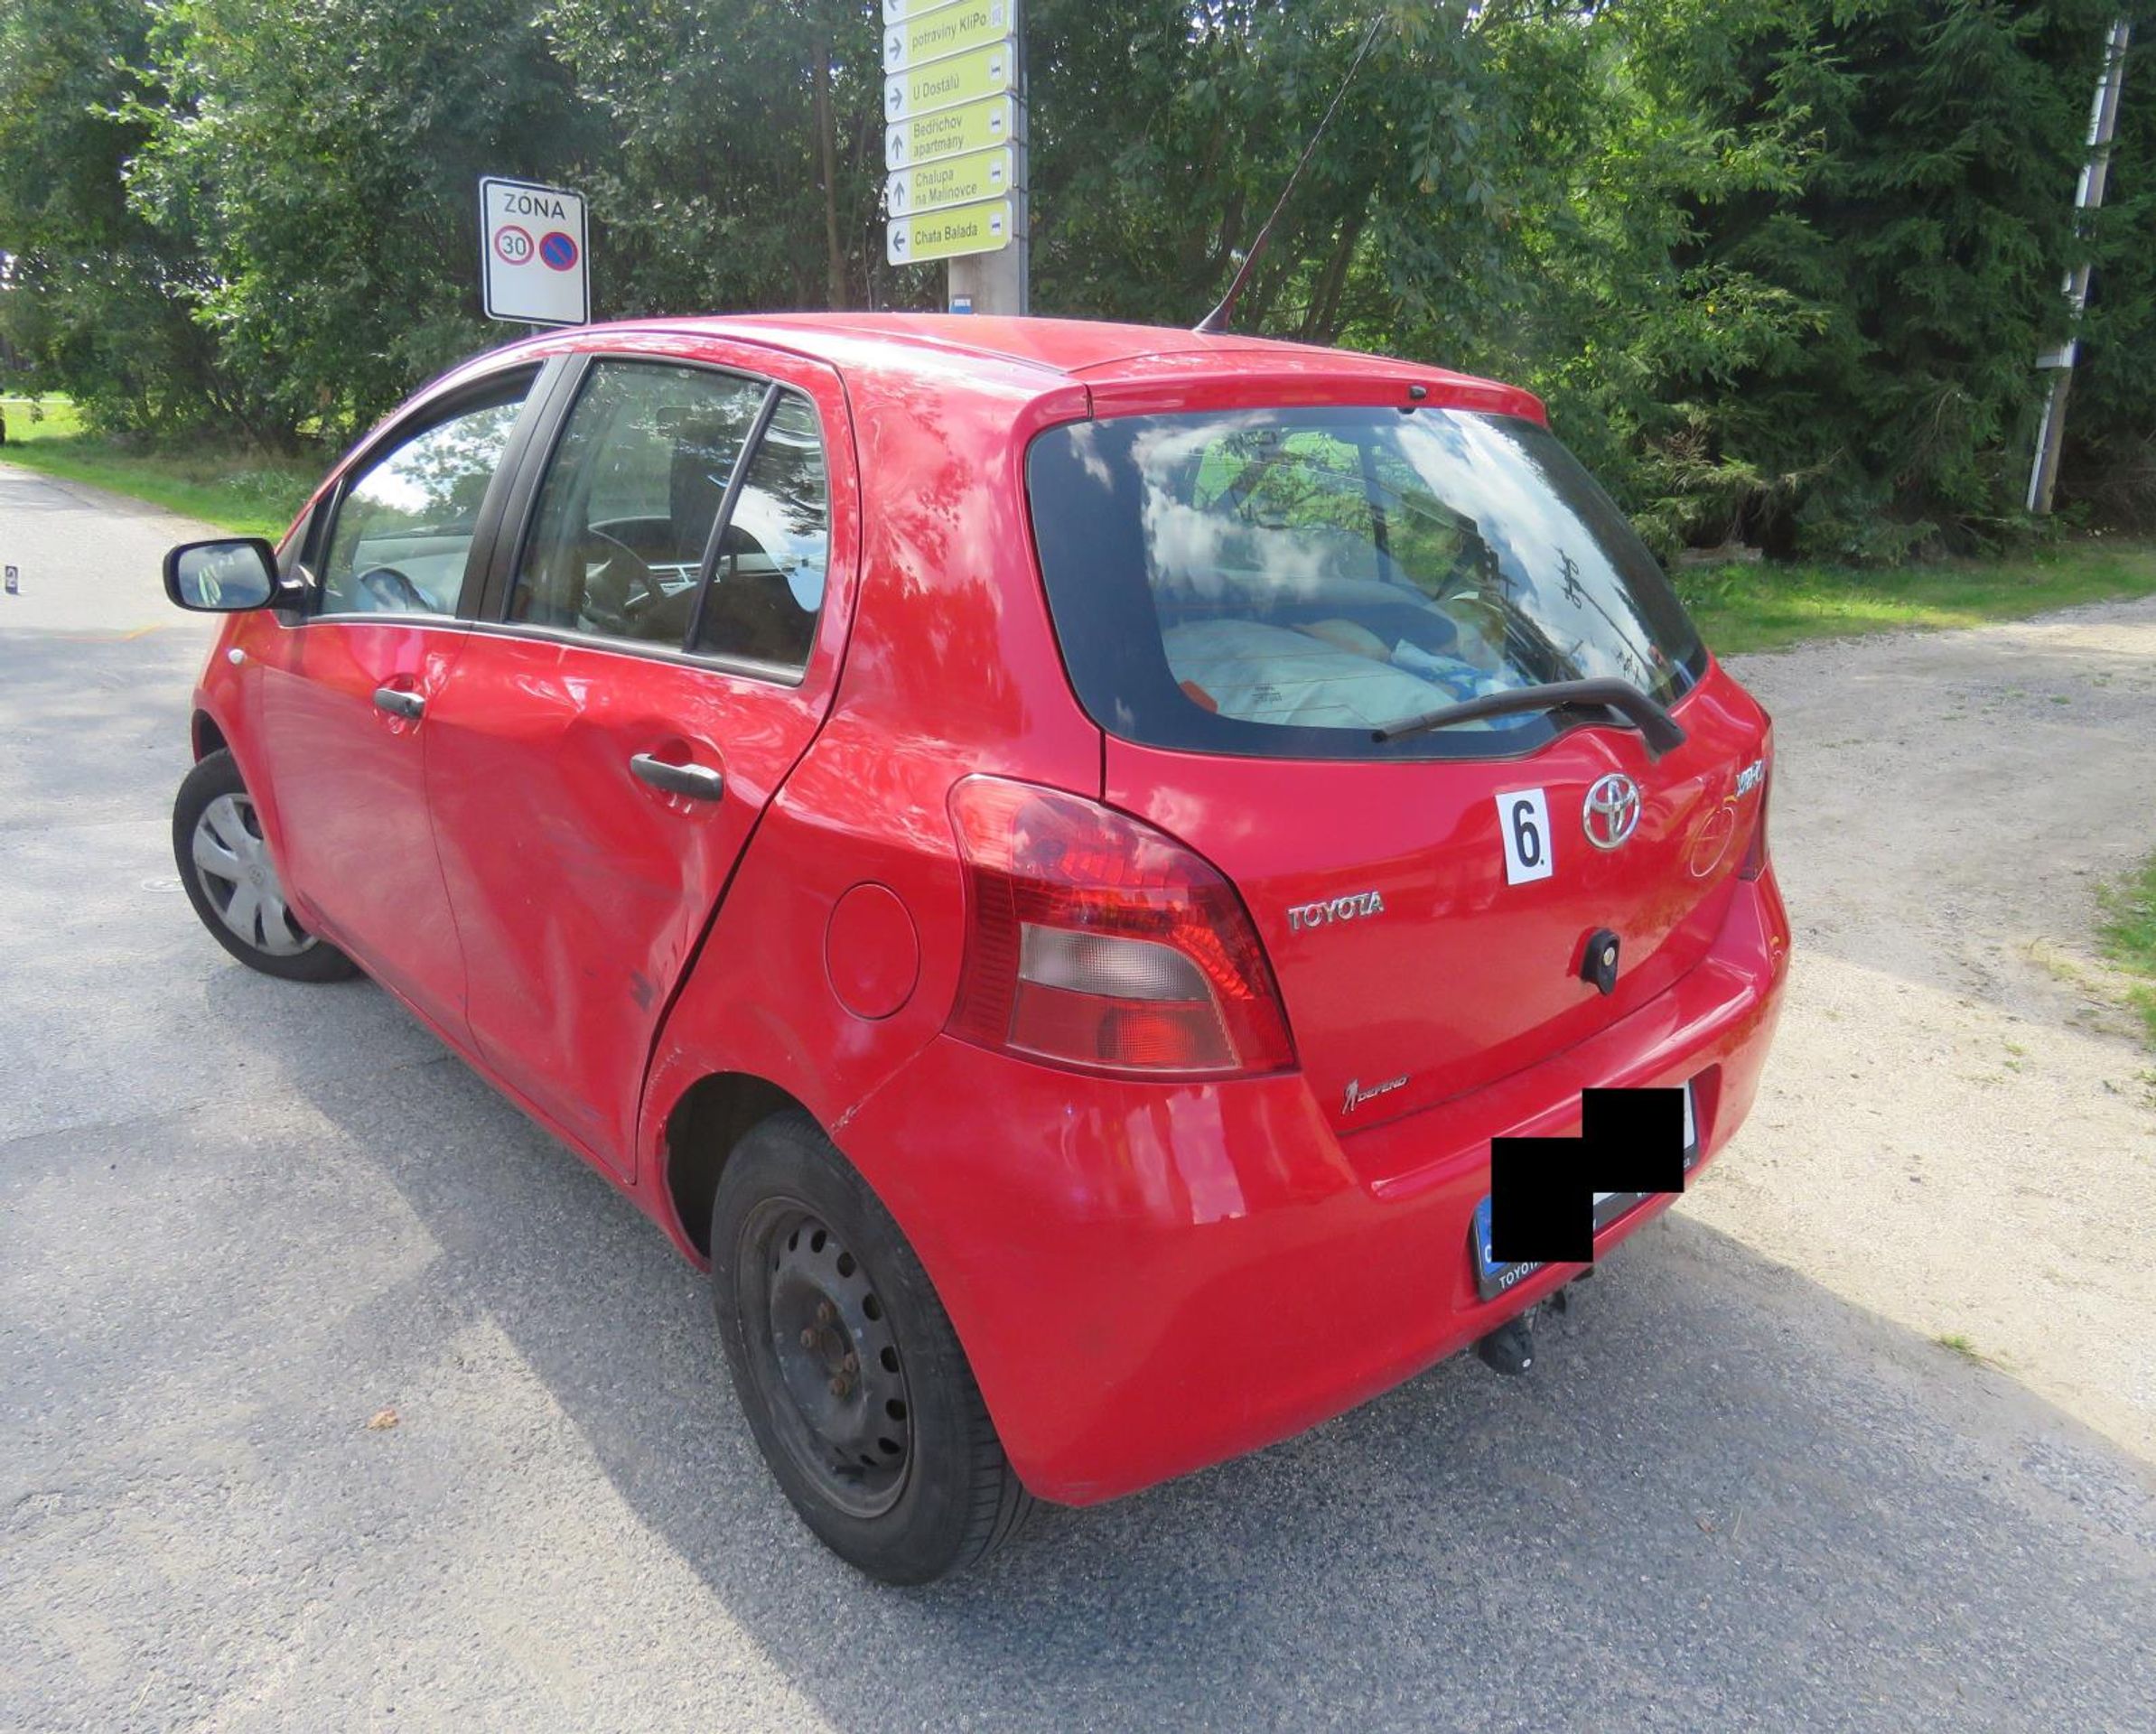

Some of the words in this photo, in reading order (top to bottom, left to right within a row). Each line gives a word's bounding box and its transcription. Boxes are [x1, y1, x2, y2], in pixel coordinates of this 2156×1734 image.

[911, 23, 957, 51] potraviny
[913, 85, 920, 100] U
[913, 116, 962, 137] Bedřichov
[916, 169, 954, 187] Chalupa
[915, 195, 926, 206] na
[929, 183, 977, 202] Malinovce
[915, 229, 941, 246] Chata
[945, 221, 978, 240] Balada
[502, 236, 527, 256] 30
[1287, 890, 1385, 930] TOYOTA
